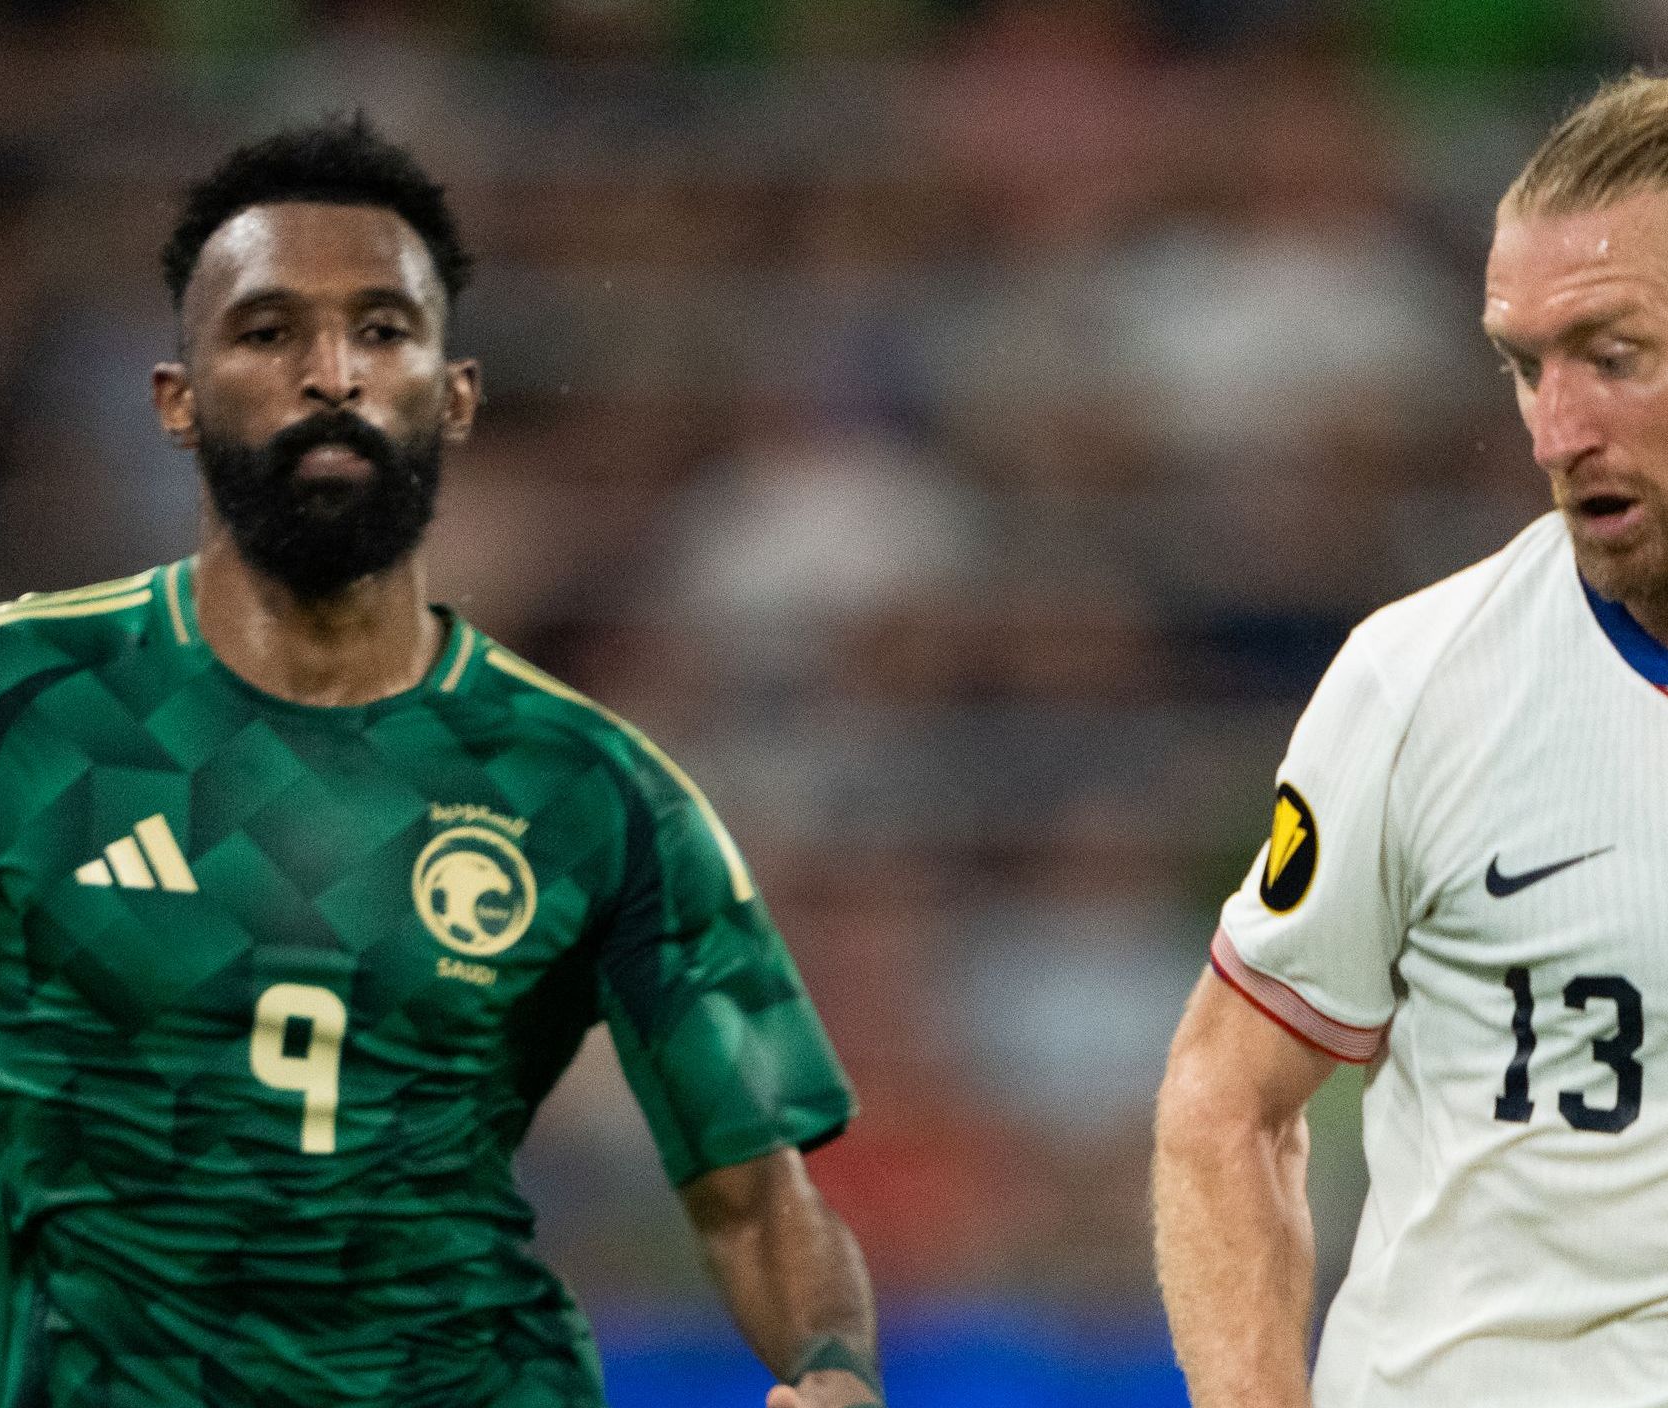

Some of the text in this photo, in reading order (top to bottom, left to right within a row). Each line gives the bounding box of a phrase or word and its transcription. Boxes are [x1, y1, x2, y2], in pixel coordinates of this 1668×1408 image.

[435, 955, 498, 987] SAUDI
[1494, 966, 1644, 1135] 13
[249, 982, 346, 1154] 9
